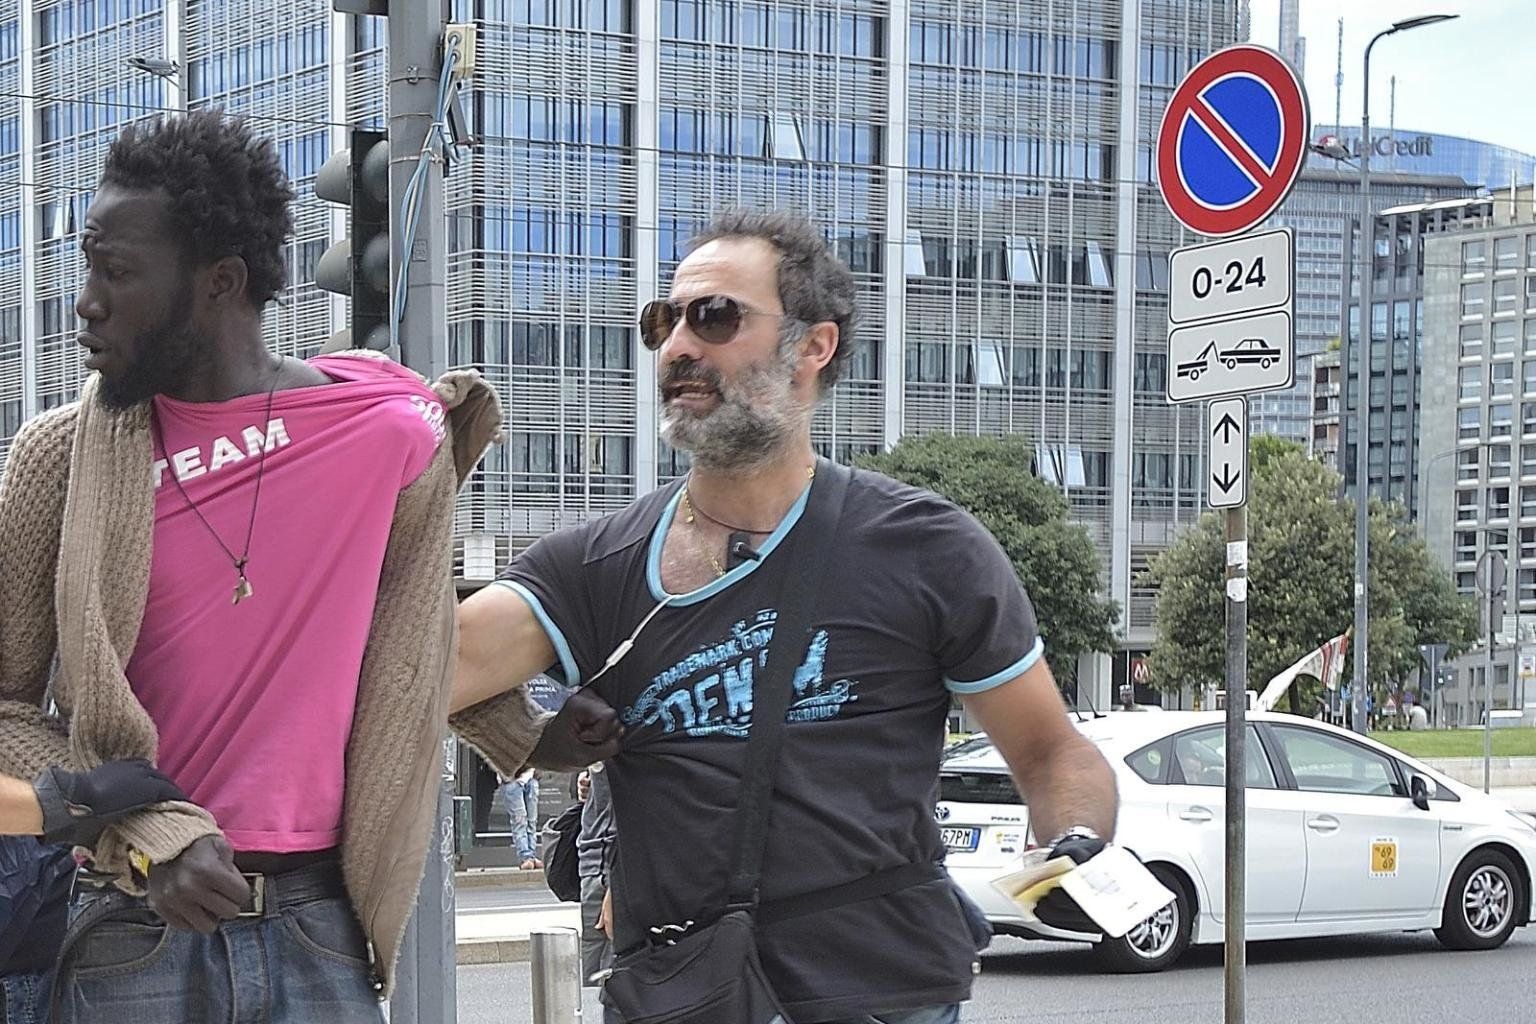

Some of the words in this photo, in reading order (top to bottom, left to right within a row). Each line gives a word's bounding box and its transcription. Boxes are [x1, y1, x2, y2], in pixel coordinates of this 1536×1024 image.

[1346, 135, 1433, 157] UiCredit
[1192, 256, 1266, 299] 0-24
[154, 417, 292, 488] TEAM
